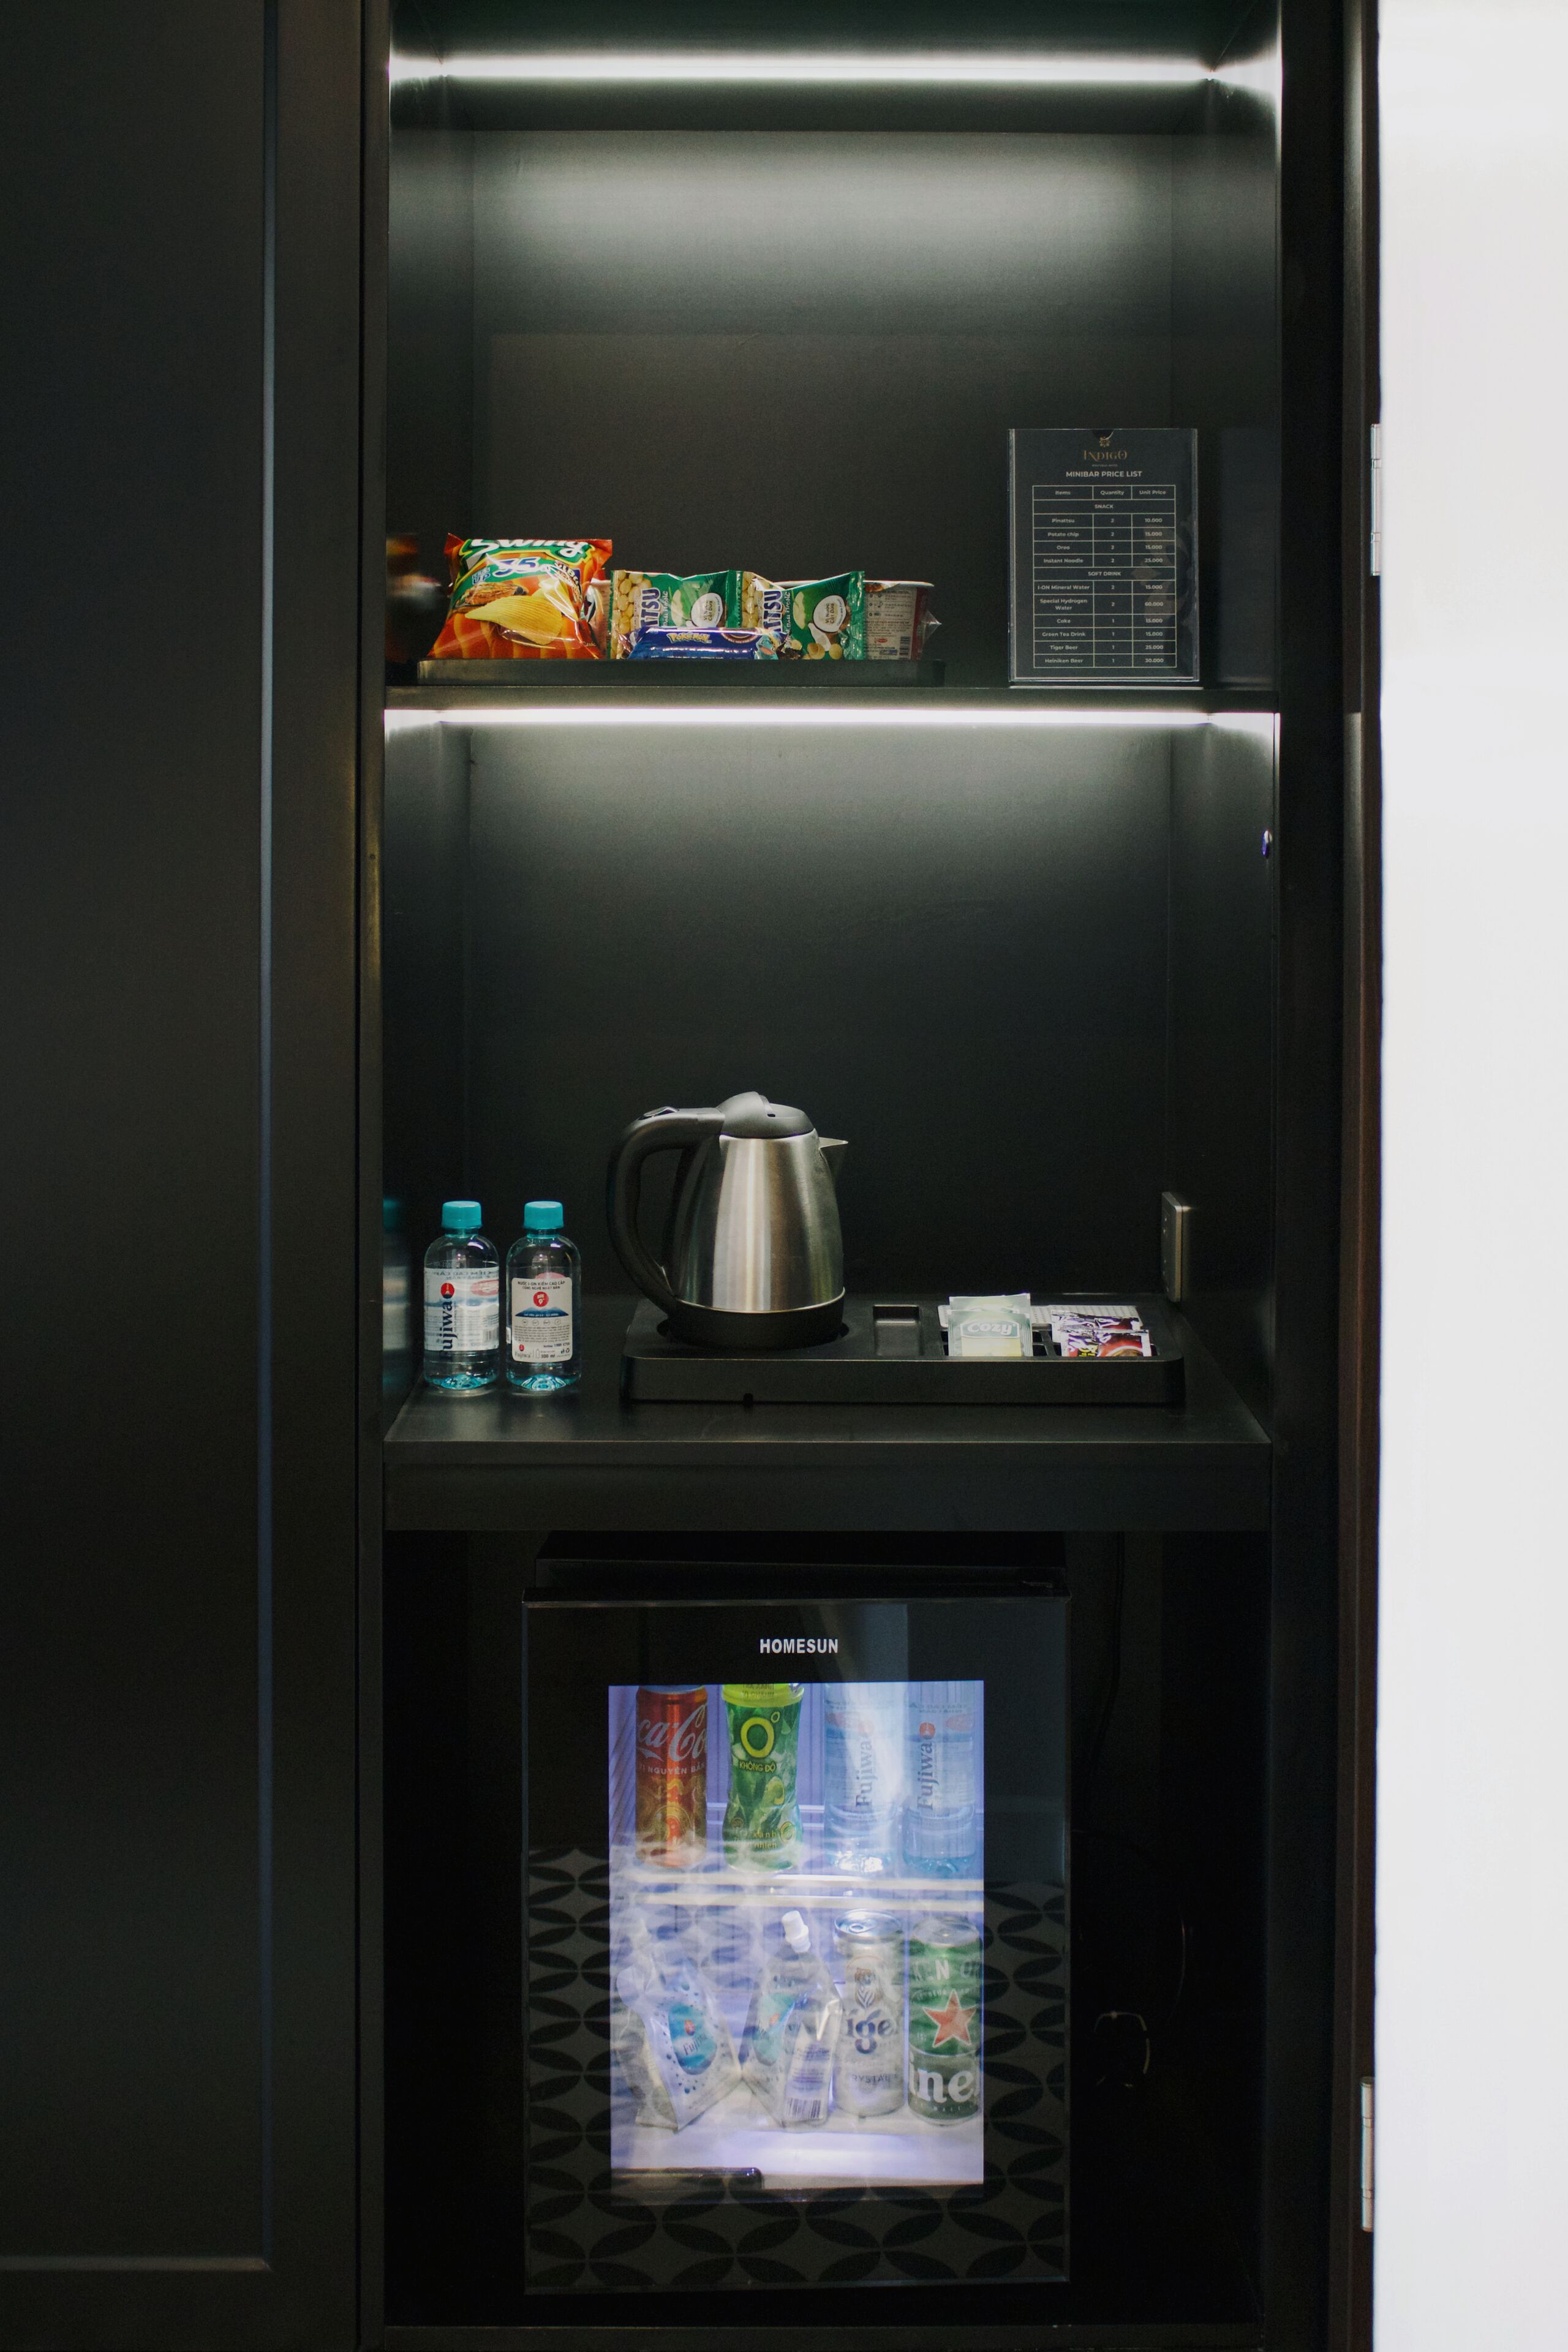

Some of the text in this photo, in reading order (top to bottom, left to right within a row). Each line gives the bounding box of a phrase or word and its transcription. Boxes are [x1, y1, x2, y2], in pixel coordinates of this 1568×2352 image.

[968, 1322, 1012, 1336] Cozy
[760, 1638, 838, 1654] HOMESUN
[647, 1765, 687, 1775] NGUYÊN
[856, 1738, 878, 1807] Fujiwa
[917, 1742, 939, 1811] Fujiwa
